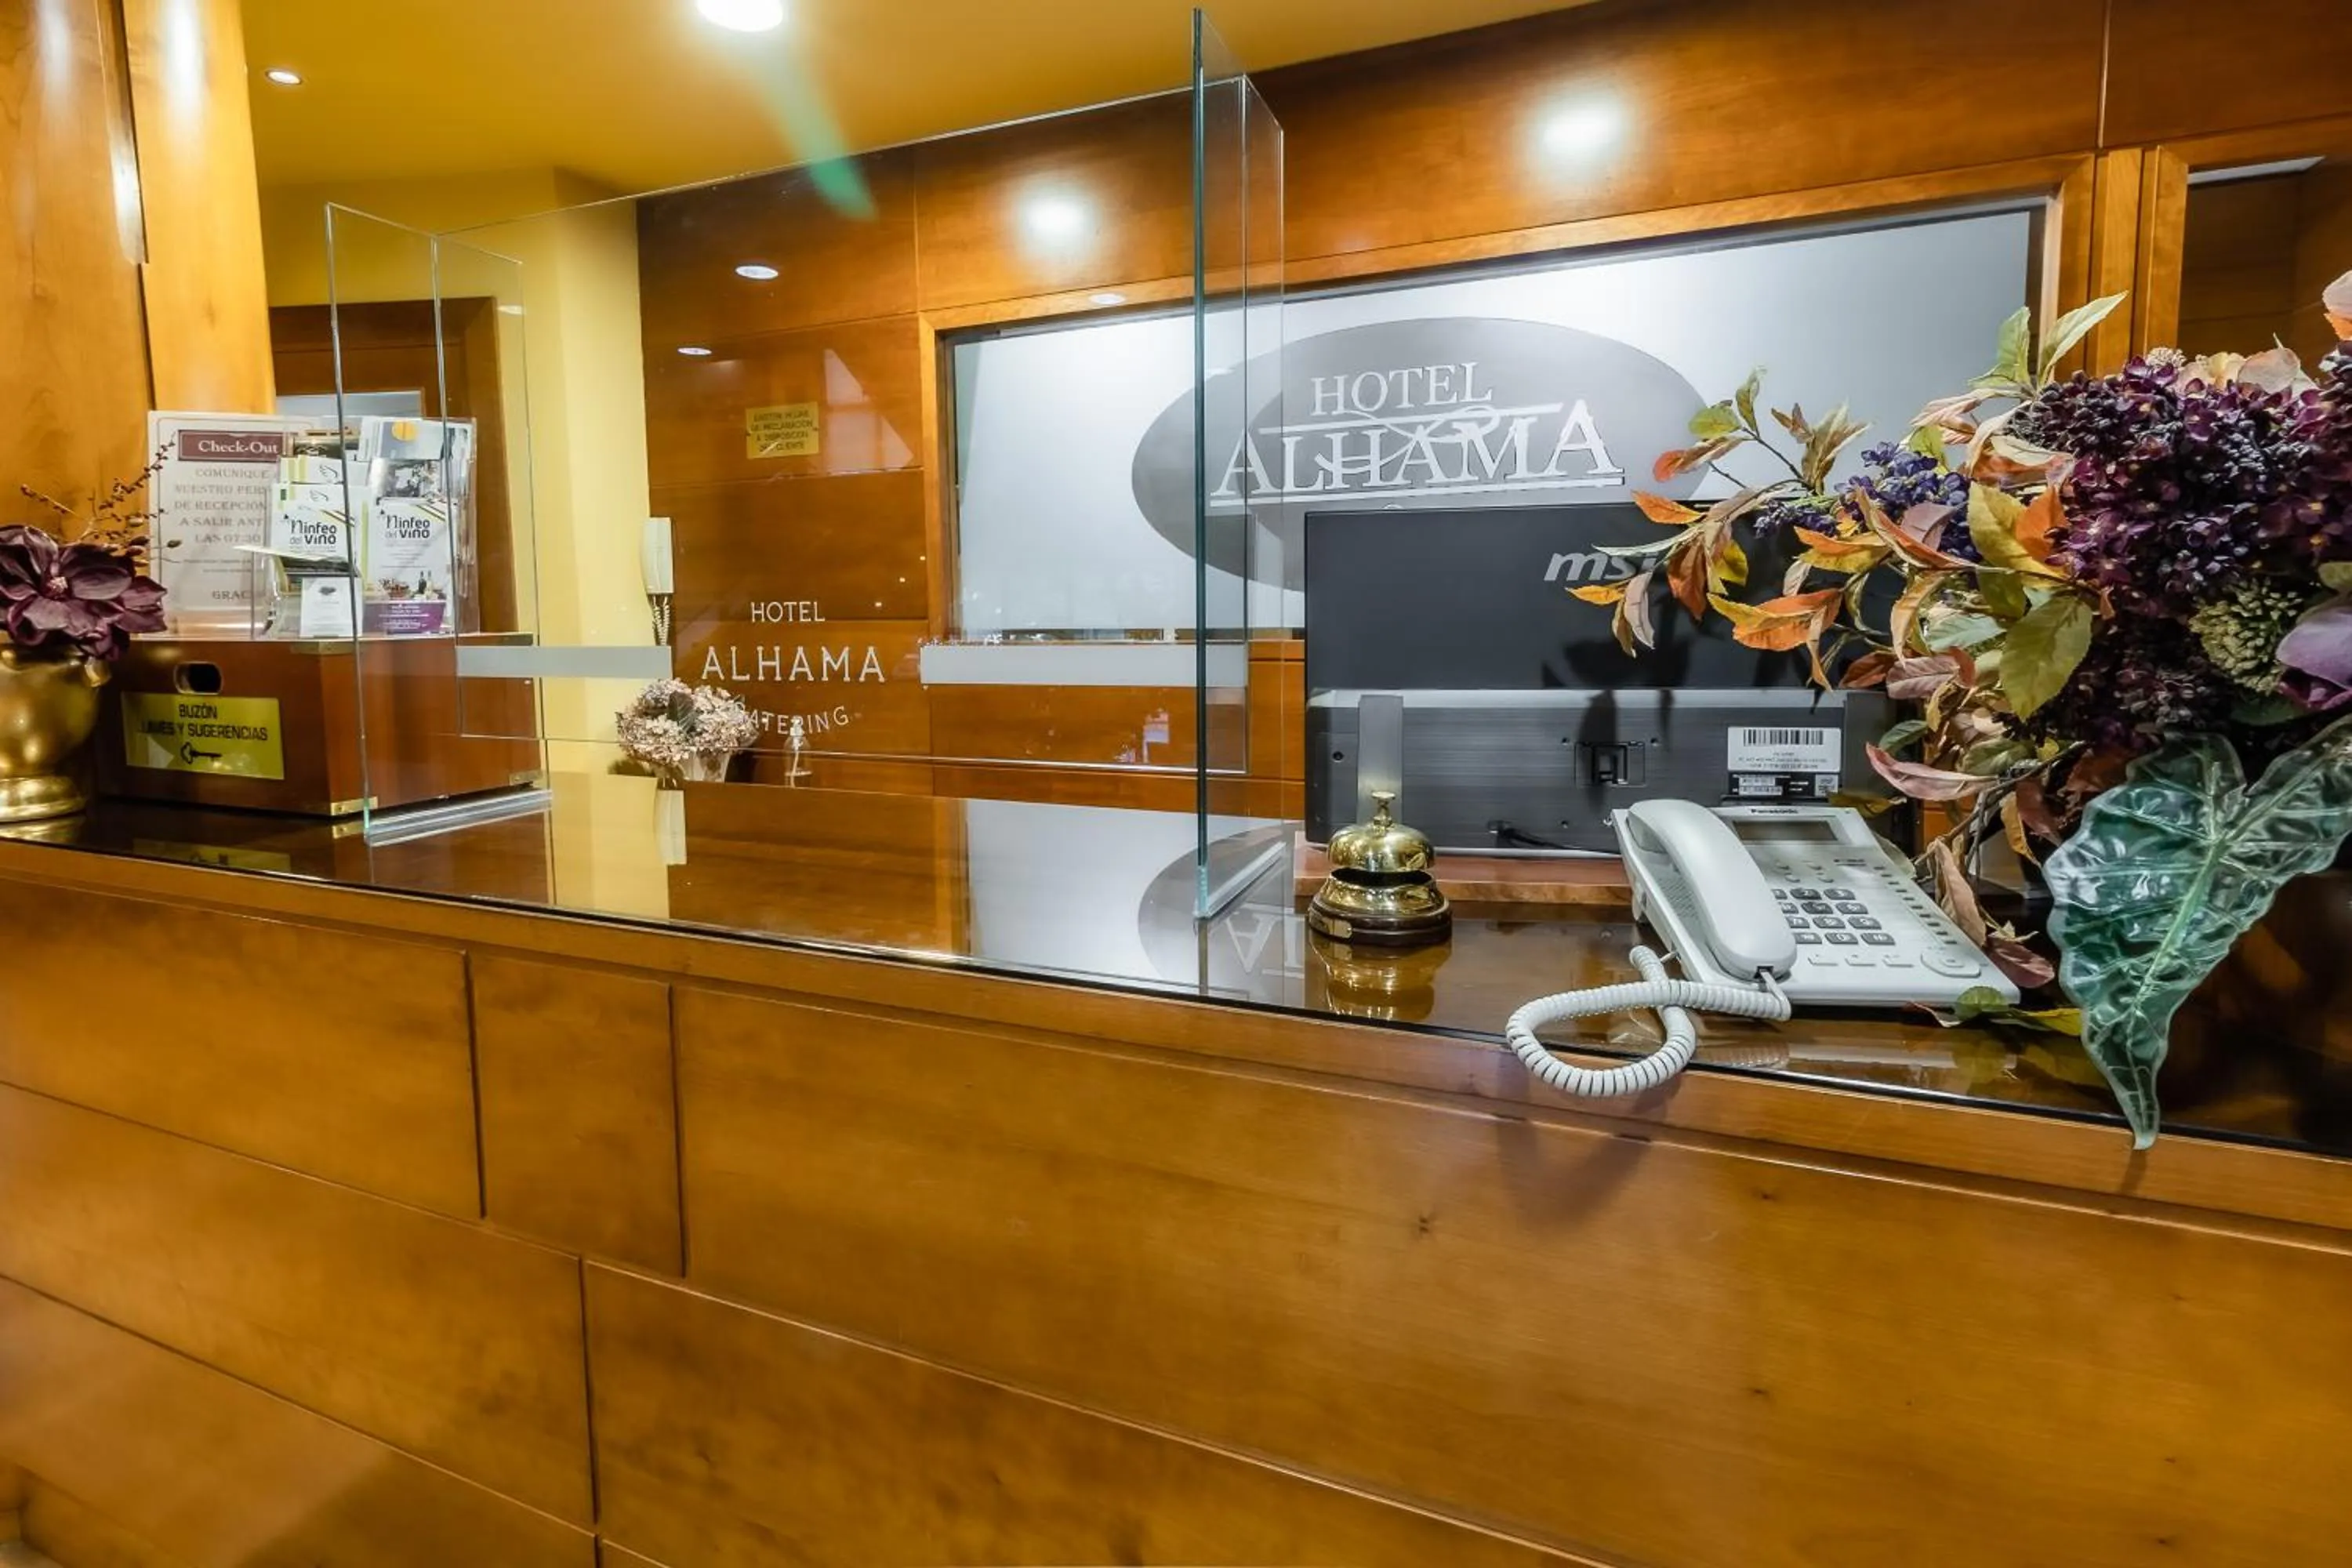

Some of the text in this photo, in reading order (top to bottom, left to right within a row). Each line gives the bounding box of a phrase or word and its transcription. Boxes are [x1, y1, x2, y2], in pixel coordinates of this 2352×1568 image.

[1310, 361, 1492, 416] HOTEL
[198, 440, 278, 453] Check-Out
[1210, 399, 1624, 496] ALHAMA
[1544, 552, 1658, 581] msi
[211, 590, 252, 600] GRAC
[750, 601, 826, 622] HOTEL
[702, 645, 885, 682] ALHAMA
[187, 723, 268, 741] SUGERENCIAS
[735, 704, 849, 735] ATERING
